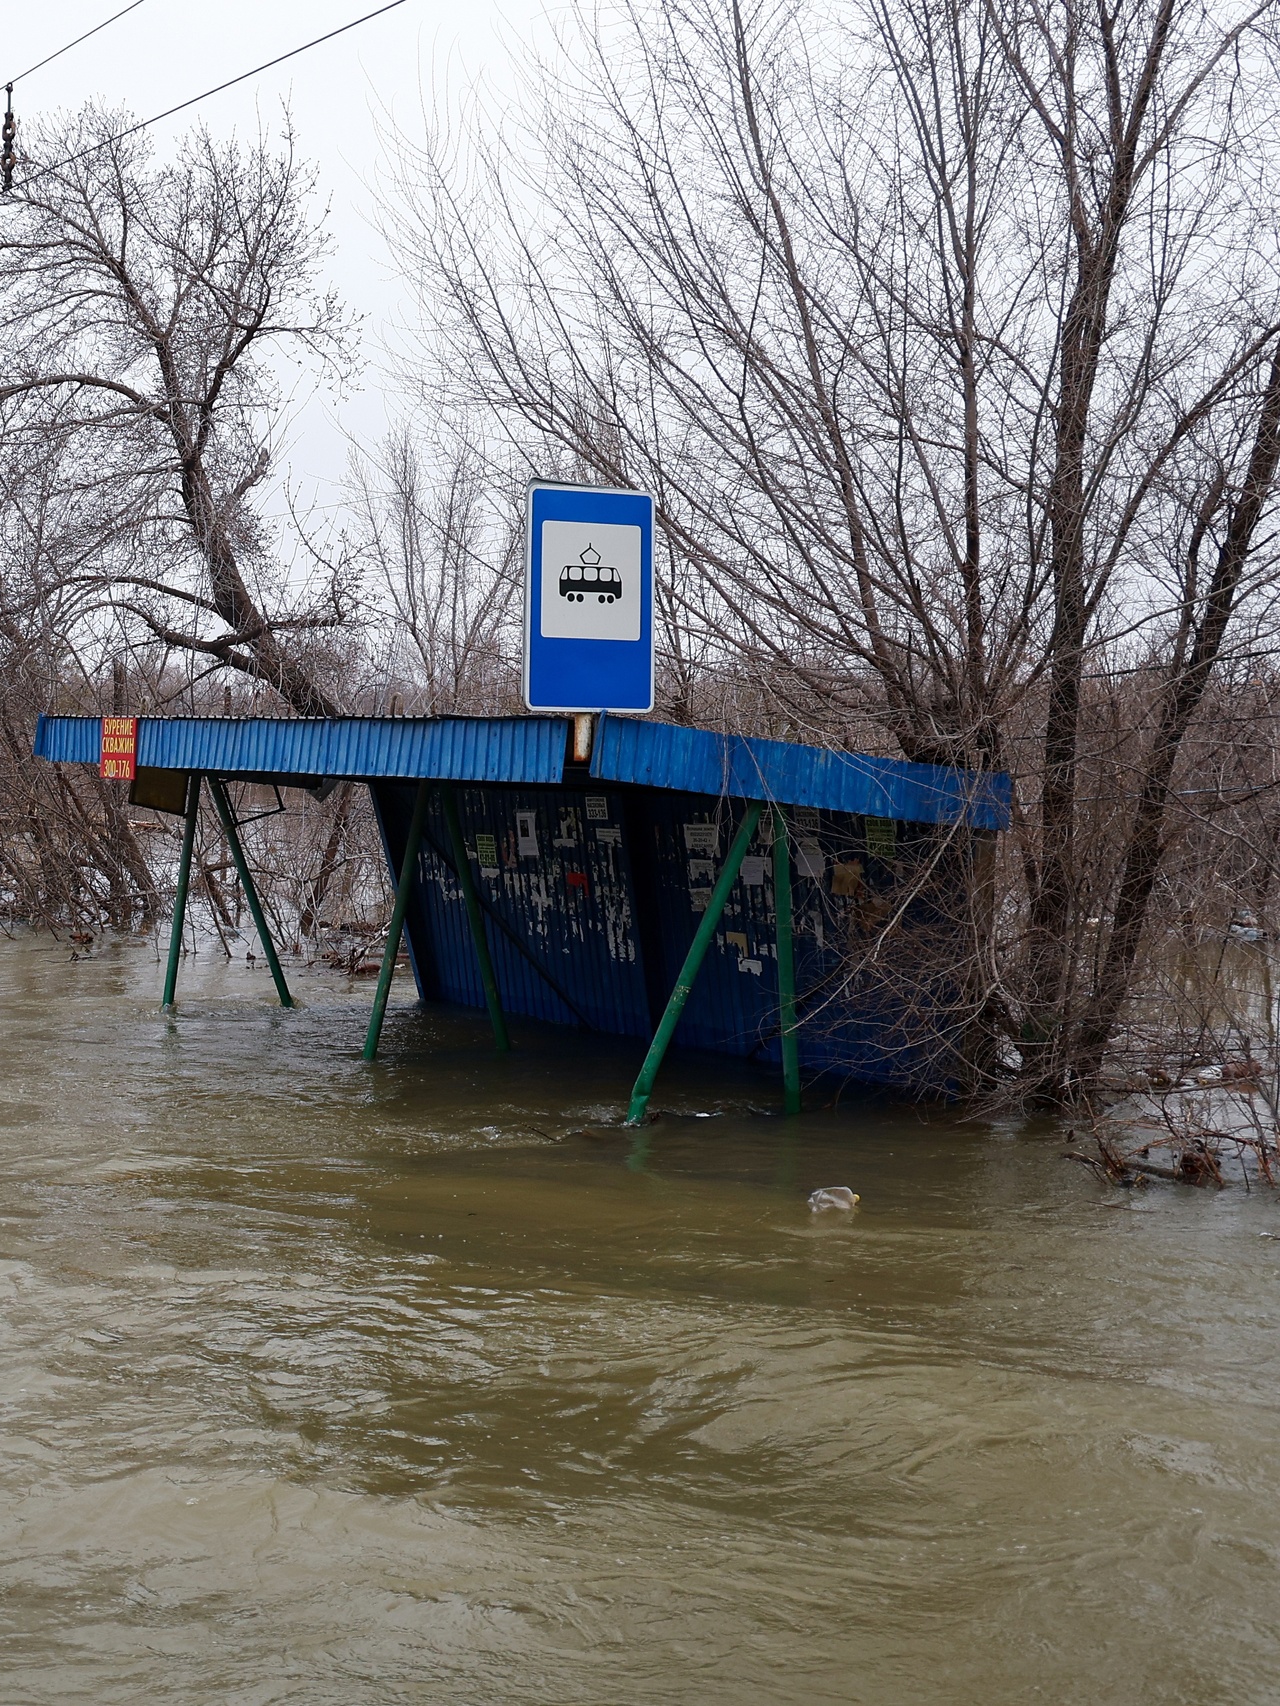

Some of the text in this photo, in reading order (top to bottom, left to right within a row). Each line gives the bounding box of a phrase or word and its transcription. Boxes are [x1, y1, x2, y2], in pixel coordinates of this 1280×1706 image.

[104, 719, 133, 735] БУРЕНИЕ
[102, 737, 134, 753] СКВАЖИН
[104, 760, 130, 777] 300-176
